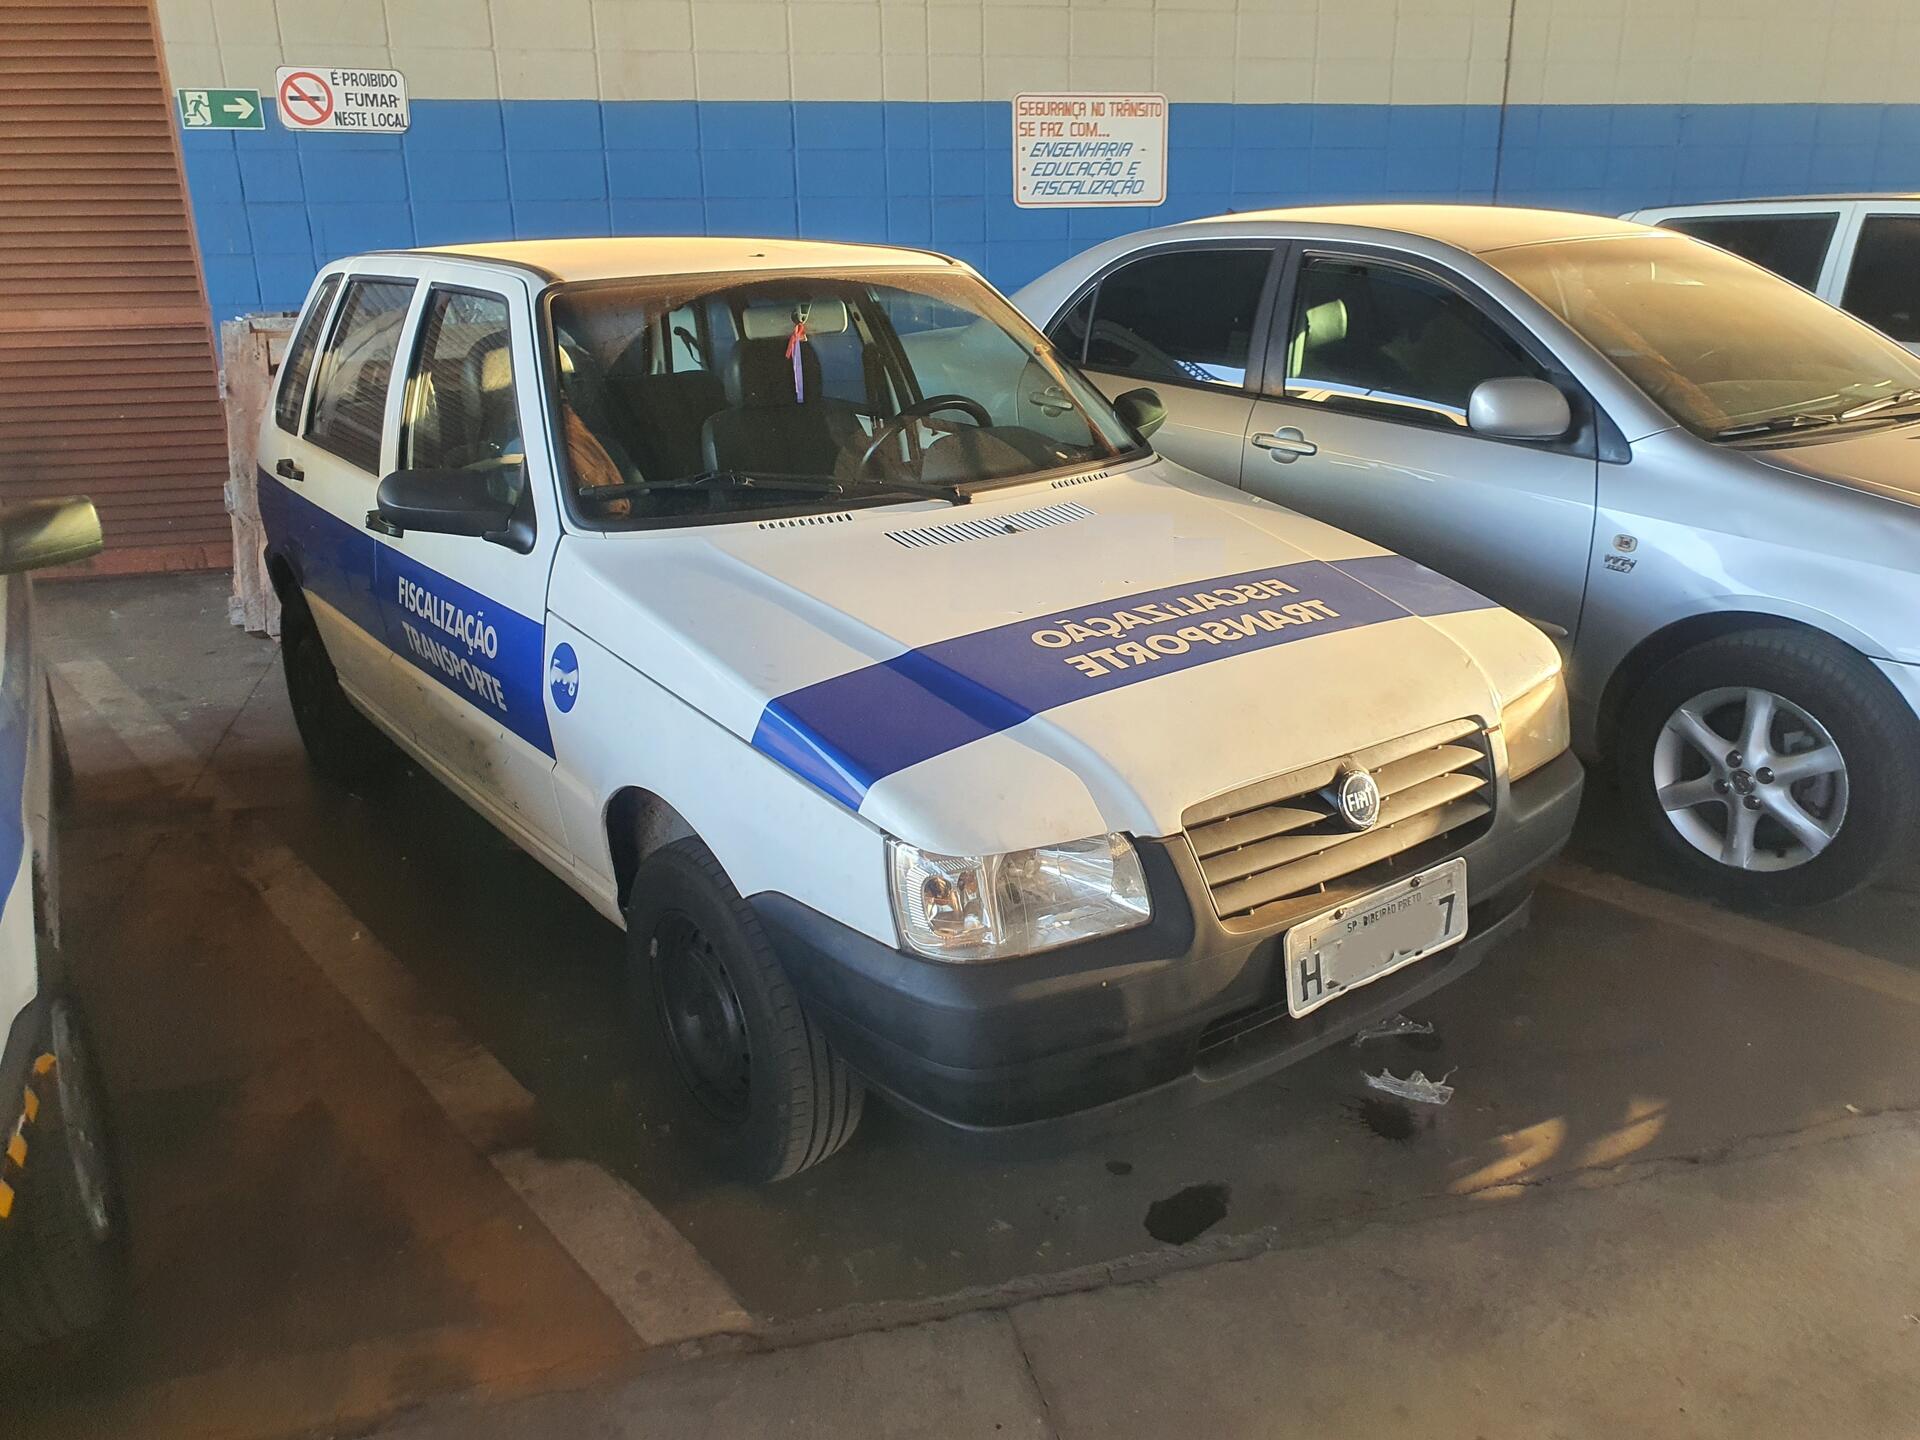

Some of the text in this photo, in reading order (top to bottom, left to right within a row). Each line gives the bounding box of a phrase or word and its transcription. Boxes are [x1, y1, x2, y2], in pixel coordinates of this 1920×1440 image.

[330, 70, 398, 87] É PROIBIDO
[344, 93, 398, 108] FUMAR
[1019, 102, 1086, 119] SEGURANÇA
[1091, 102, 1105, 116] NO
[334, 112, 407, 128] NESTE LOCAL
[1019, 122, 1035, 136] SE
[1040, 122, 1064, 137] FAZ
[1030, 142, 1133, 157] ENGENHARIA
[1031, 159, 1141, 177] EDUCAÇÃO E
[1031, 177, 1144, 197] FISCALIZAÇÃO
[399, 576, 498, 659] FISCALIZAÇÃO
[402, 621, 508, 712] TRANSPORTE
[1347, 789, 1374, 812] FIAT
